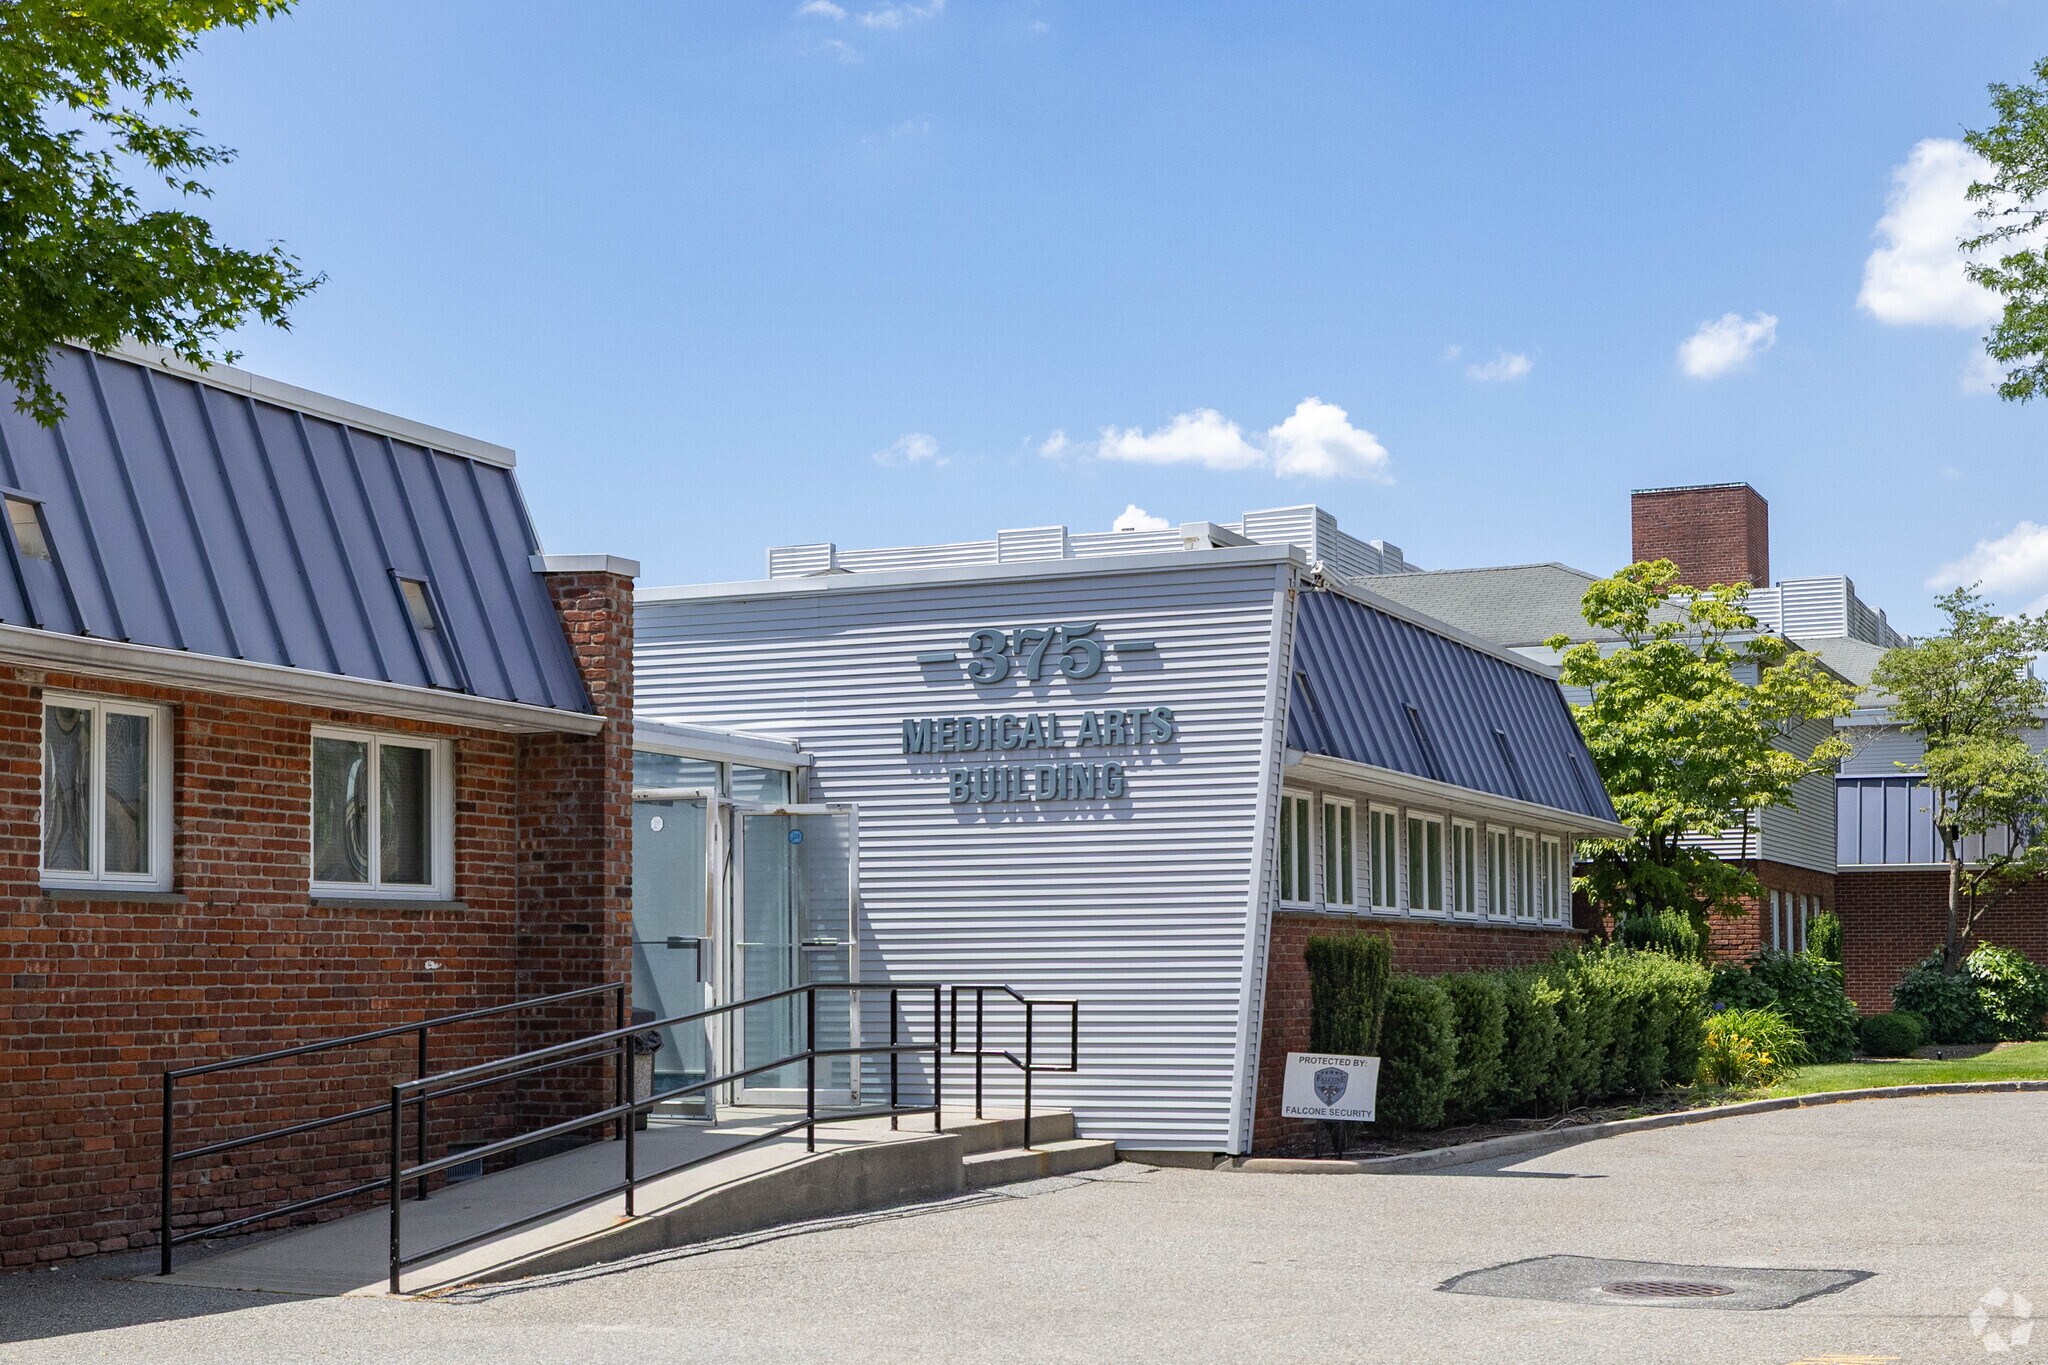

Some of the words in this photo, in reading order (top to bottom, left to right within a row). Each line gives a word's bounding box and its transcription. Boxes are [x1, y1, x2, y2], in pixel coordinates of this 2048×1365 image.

[902, 713, 1066, 753] MEDICAL
[1075, 706, 1174, 746] ARTS
[949, 761, 1124, 803] BUILDING
[1298, 1056, 1351, 1067] PROTECTED
[1353, 1059, 1368, 1068] BY:
[1285, 1106, 1327, 1116] FALCONE
[1328, 1108, 1372, 1118] SECURITY
